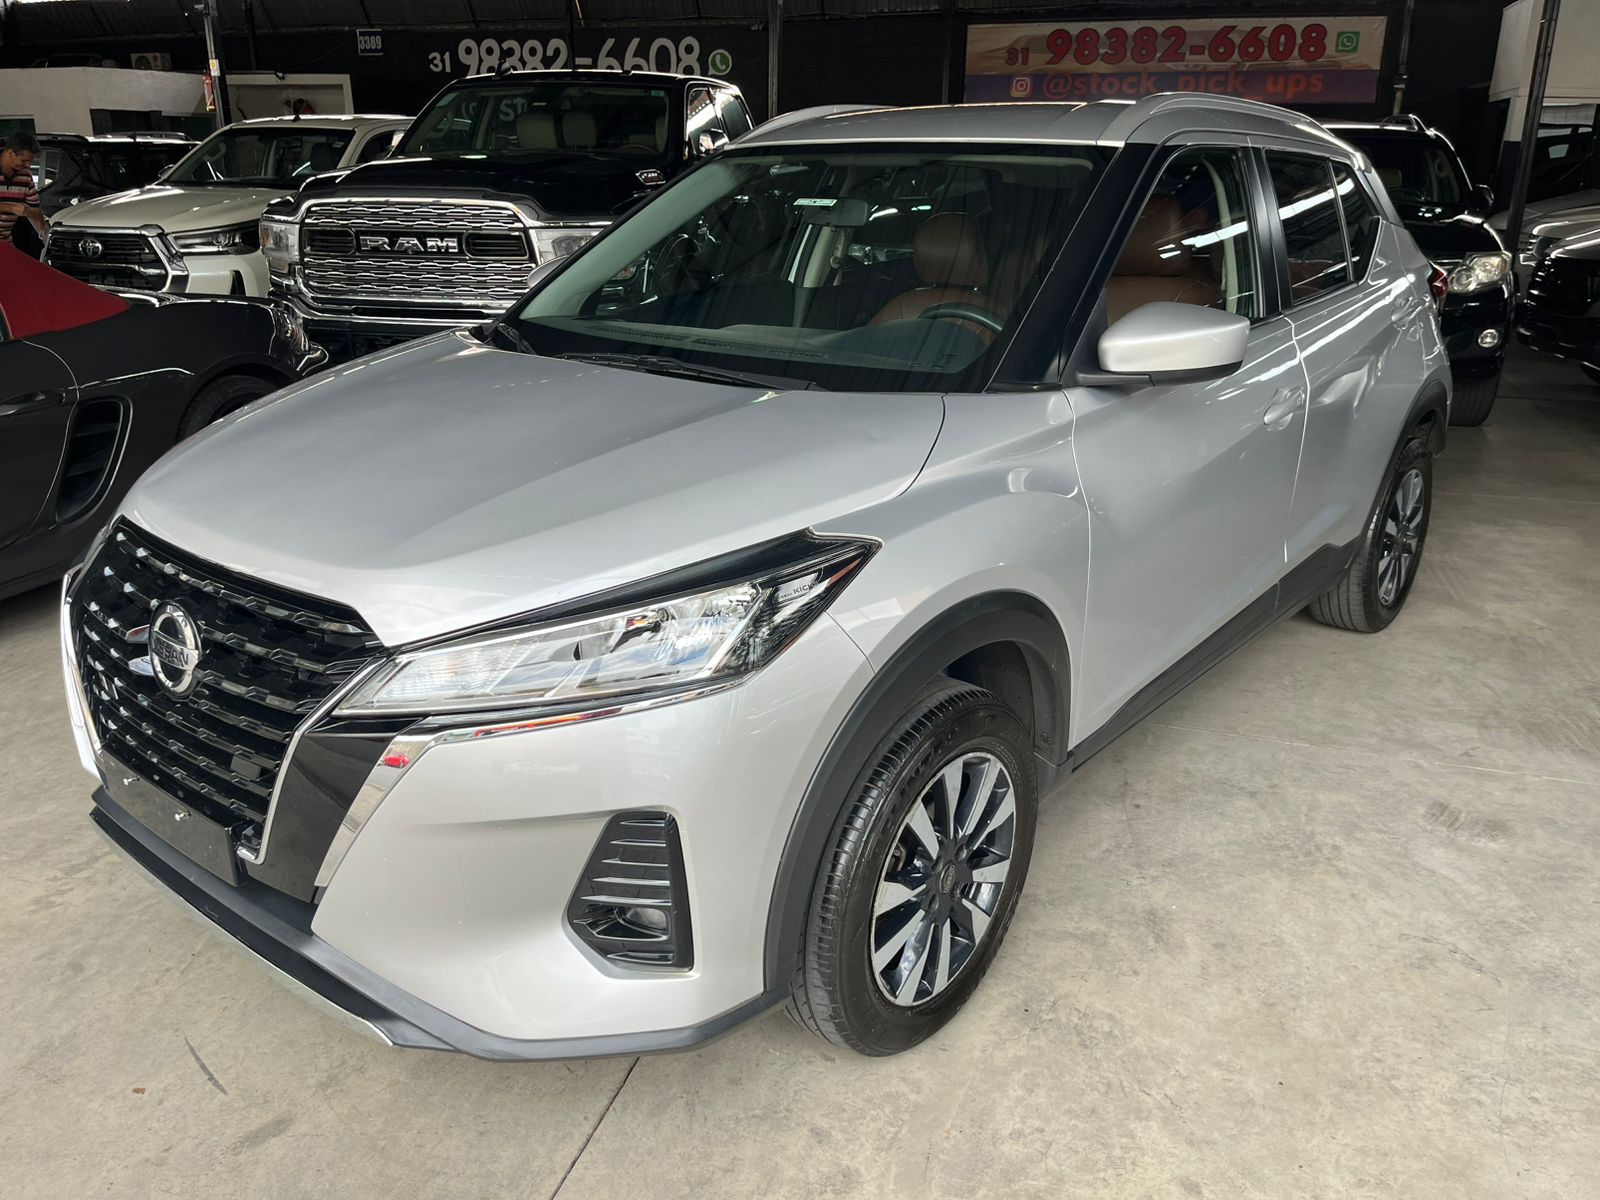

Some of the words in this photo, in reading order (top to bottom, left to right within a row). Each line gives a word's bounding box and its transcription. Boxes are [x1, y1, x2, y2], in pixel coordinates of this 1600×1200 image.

[359, 35, 382, 50] 3389
[1005, 47, 1030, 66] 31
[1045, 23, 1329, 67] 98382-6608
[428, 50, 452, 74] 31
[457, 36, 701, 79] 98382-6608
[359, 236, 459, 252] RAM
[793, 582, 816, 594] KICK
